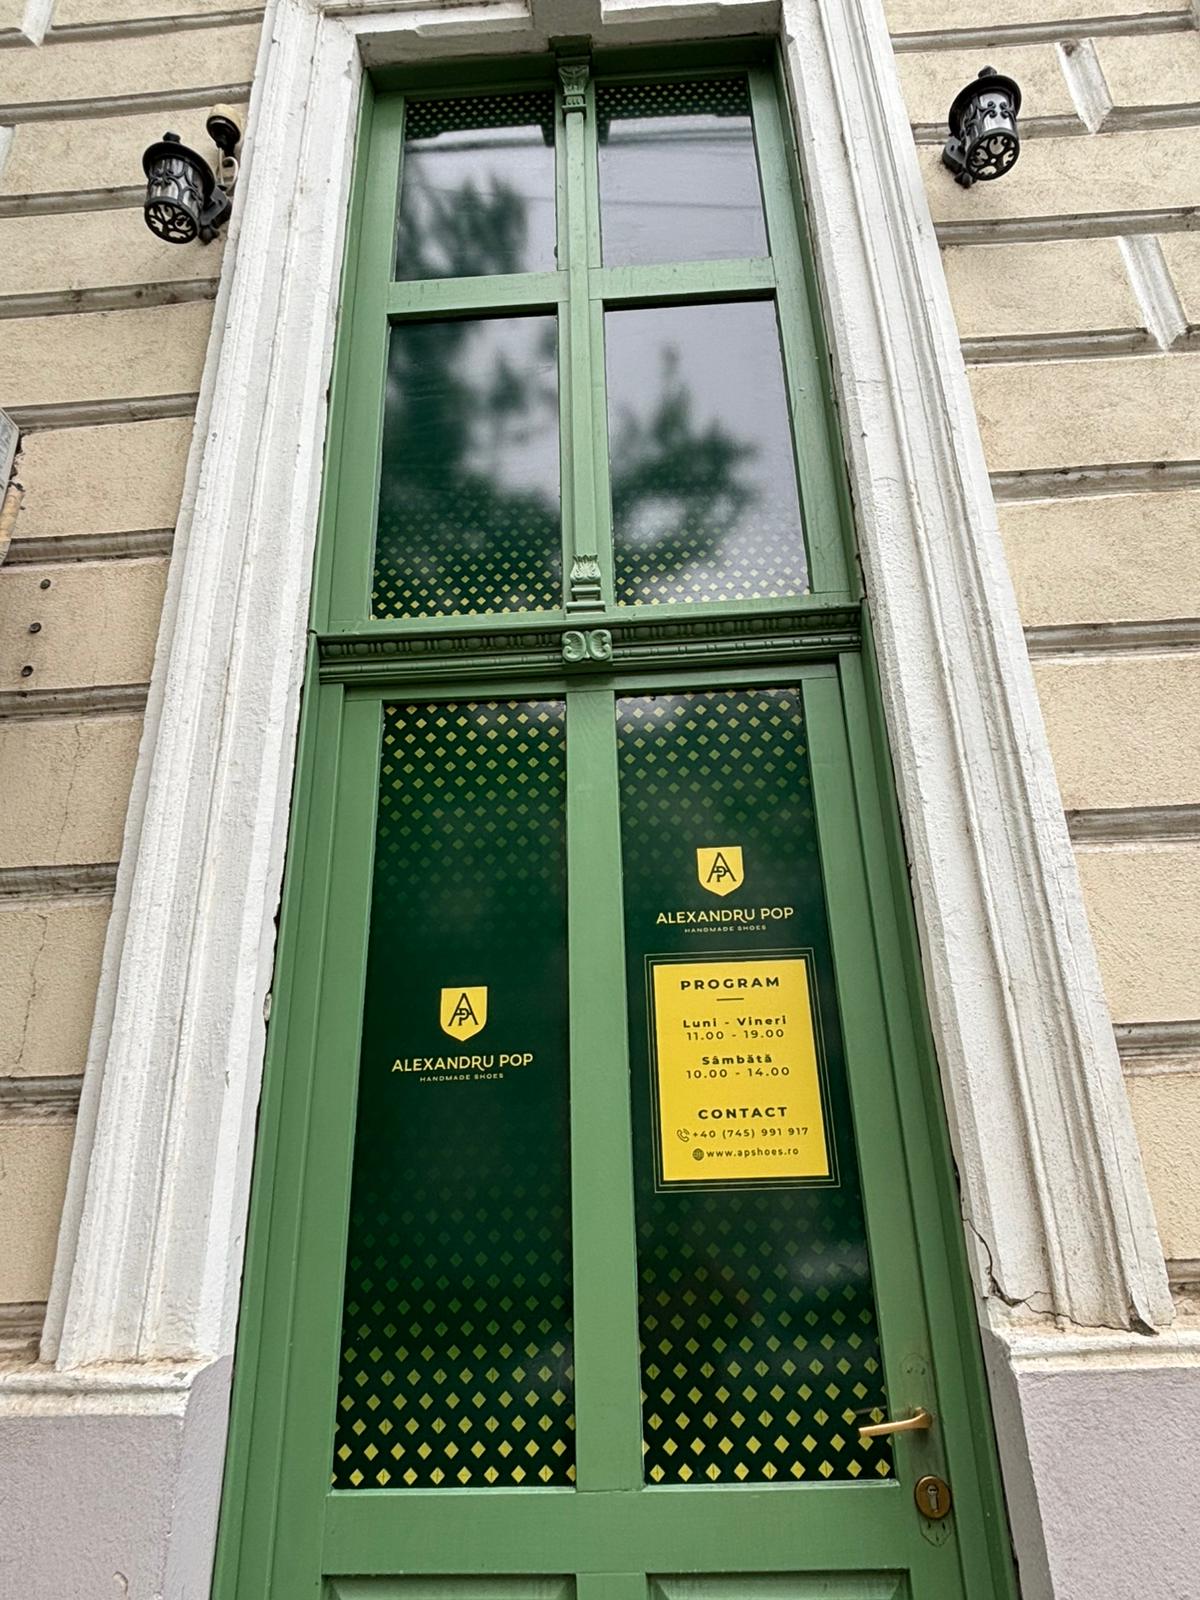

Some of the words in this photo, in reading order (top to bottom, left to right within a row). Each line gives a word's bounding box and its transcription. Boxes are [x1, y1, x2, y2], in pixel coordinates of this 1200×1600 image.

[656, 908, 756, 925] ALEXANDRU
[760, 907, 794, 920] POP
[680, 977, 780, 990] PROGRAM
[683, 1018, 717, 1028] Luni
[737, 1015, 786, 1026] Vineri
[687, 1030, 724, 1041] 11.00
[744, 1029, 784, 1039] 19.00
[391, 1054, 494, 1073] ALEXANDRU
[499, 1053, 534, 1067] POP
[702, 1054, 772, 1065] Sâmbătă
[420, 1074, 471, 1082] HANDMADE
[687, 1069, 728, 1079] 10.00
[748, 1067, 790, 1077] 14.00
[698, 1106, 788, 1120] CONTACT
[693, 1130, 716, 1138] +40
[722, 1129, 755, 1139] (745)
[761, 1128, 782, 1137] 991
[788, 1127, 809, 1136] 917
[706, 1147, 799, 1158] www.apshoes.ro
